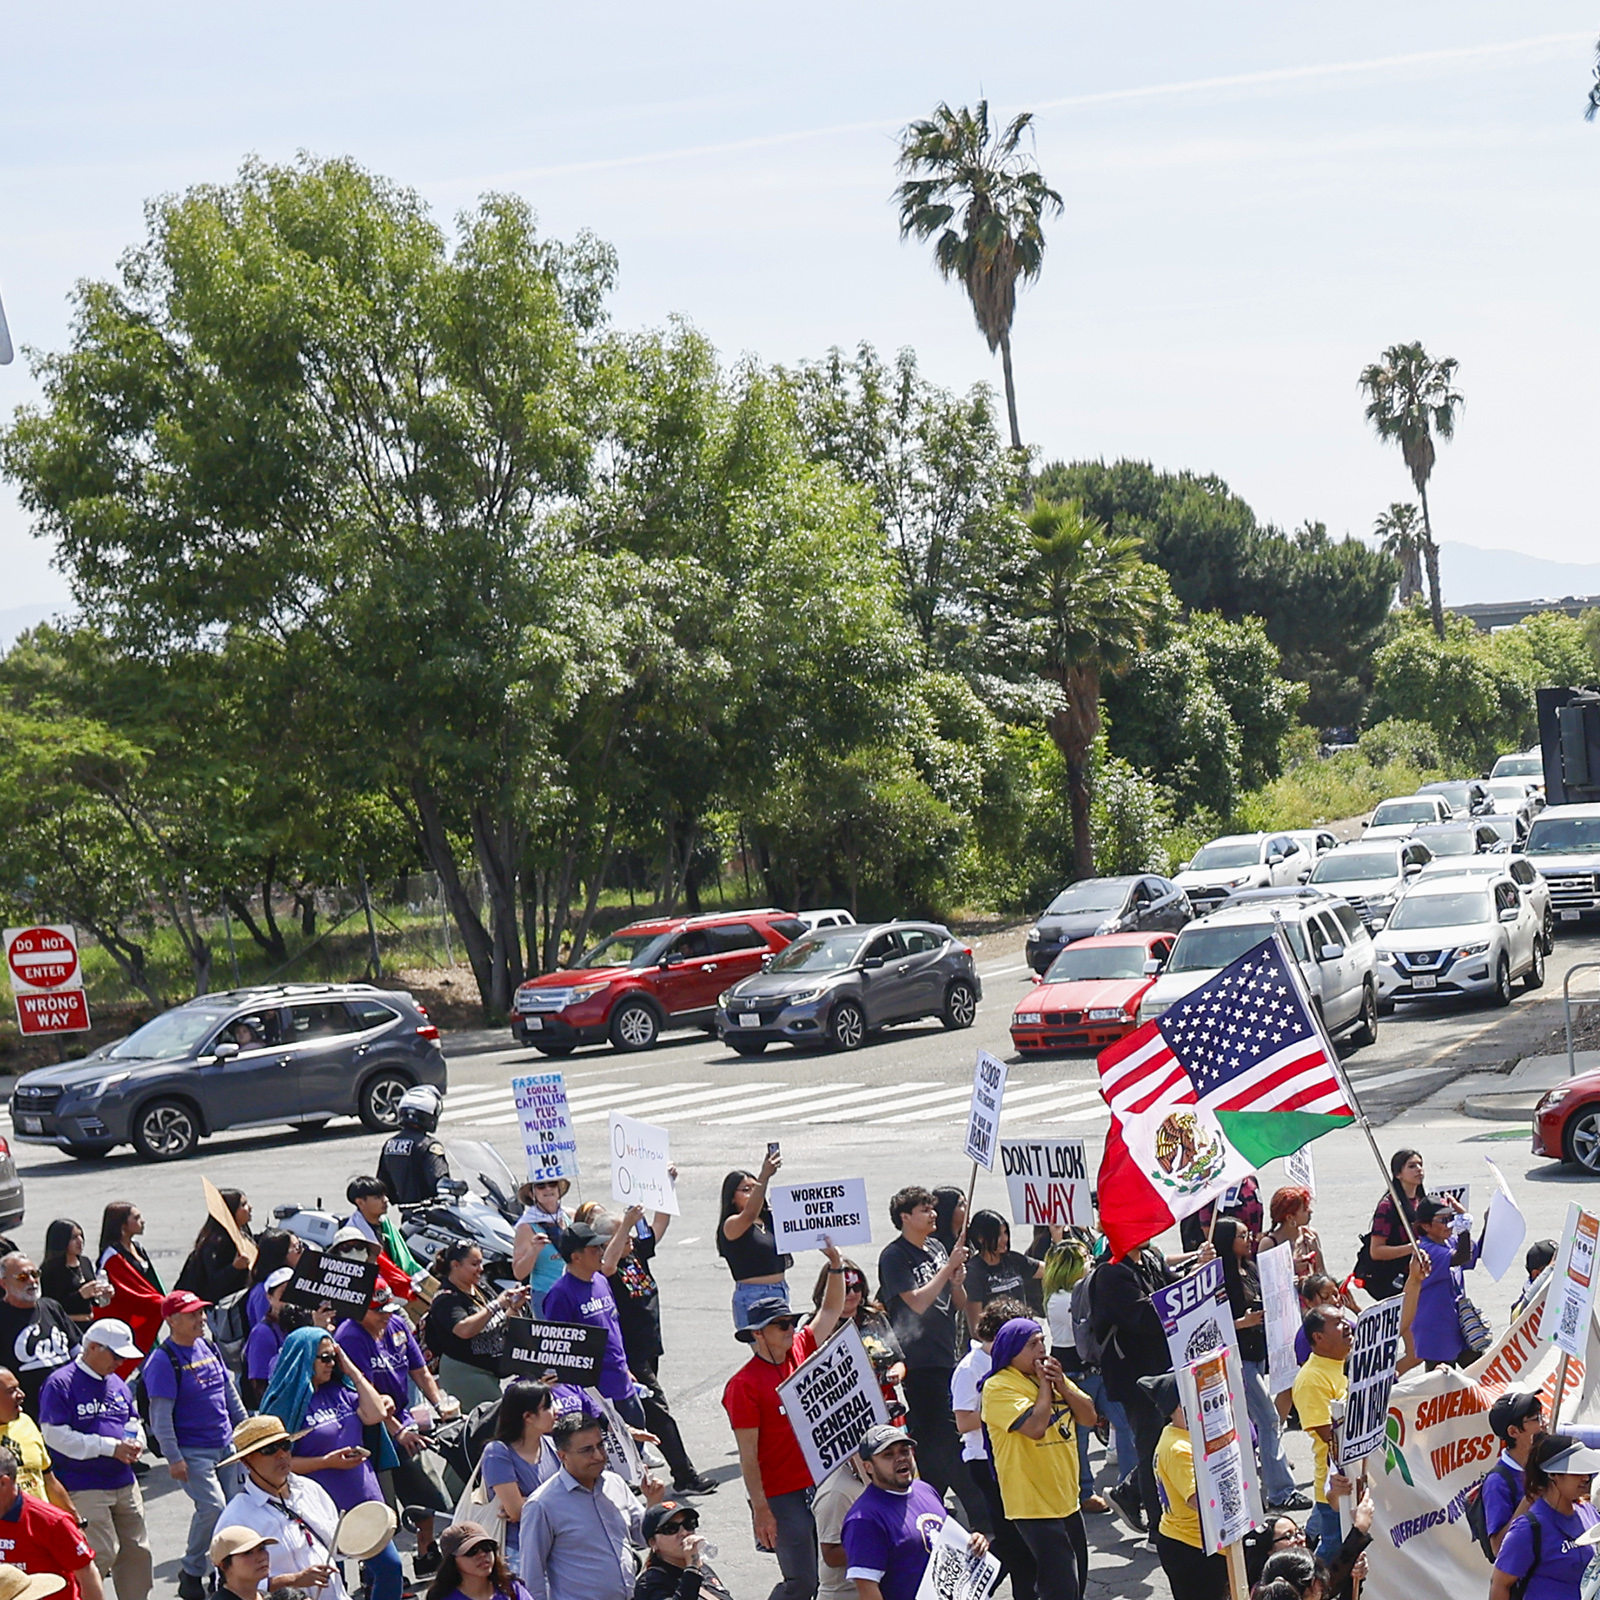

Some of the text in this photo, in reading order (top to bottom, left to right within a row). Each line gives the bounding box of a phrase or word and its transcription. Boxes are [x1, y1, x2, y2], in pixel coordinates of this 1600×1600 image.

[16, 937, 65, 951] DO NOT
[25, 965, 66, 979] ENTER
[24, 996, 79, 1013] WRONG
[37, 1012, 70, 1028] WAY
[512, 1074, 562, 1089] FASCISM
[526, 1085, 558, 1095] EQUALS
[515, 1093, 567, 1110] CAPITALISM
[535, 1107, 557, 1119] PLUS
[524, 1117, 567, 1132] MURDER
[540, 1131, 554, 1142] NO
[614, 1123, 664, 1160] Overthrow
[541, 1154, 558, 1167] NO
[1000, 1143, 1085, 1179] DON'T LOOK
[535, 1166, 563, 1180] ICE
[791, 1185, 845, 1203] WORKERS
[804, 1201, 834, 1216] OVER
[1024, 1182, 1075, 1225] AWAY
[783, 1212, 860, 1234] BILLIONAIRES!
[319, 1256, 365, 1277] WORKERS
[323, 1271, 351, 1289] OVER
[294, 1277, 367, 1305] BILLIONAIRES!
[1165, 1264, 1217, 1317] SEIU
[580, 1297, 602, 1314] seiu
[530, 1323, 587, 1341] WORKERS
[1355, 1303, 1402, 1351] STOP THE
[540, 1339, 572, 1353] OVER
[511, 1347, 595, 1369] BILLIONAIRES!
[1352, 1339, 1399, 1380] WAR
[1502, 1337, 1525, 1374] BY
[793, 1341, 850, 1394] MAY 1:
[801, 1354, 854, 1411] STAND UP
[805, 1371, 860, 1423] TO TRUMP
[306, 1408, 336, 1426] seiu
[811, 1390, 872, 1449] GENERAL
[1346, 1394, 1366, 1441] ON
[1429, 1433, 1495, 1481] UNLESS
[1389, 1508, 1446, 1549] QUEREMOS
